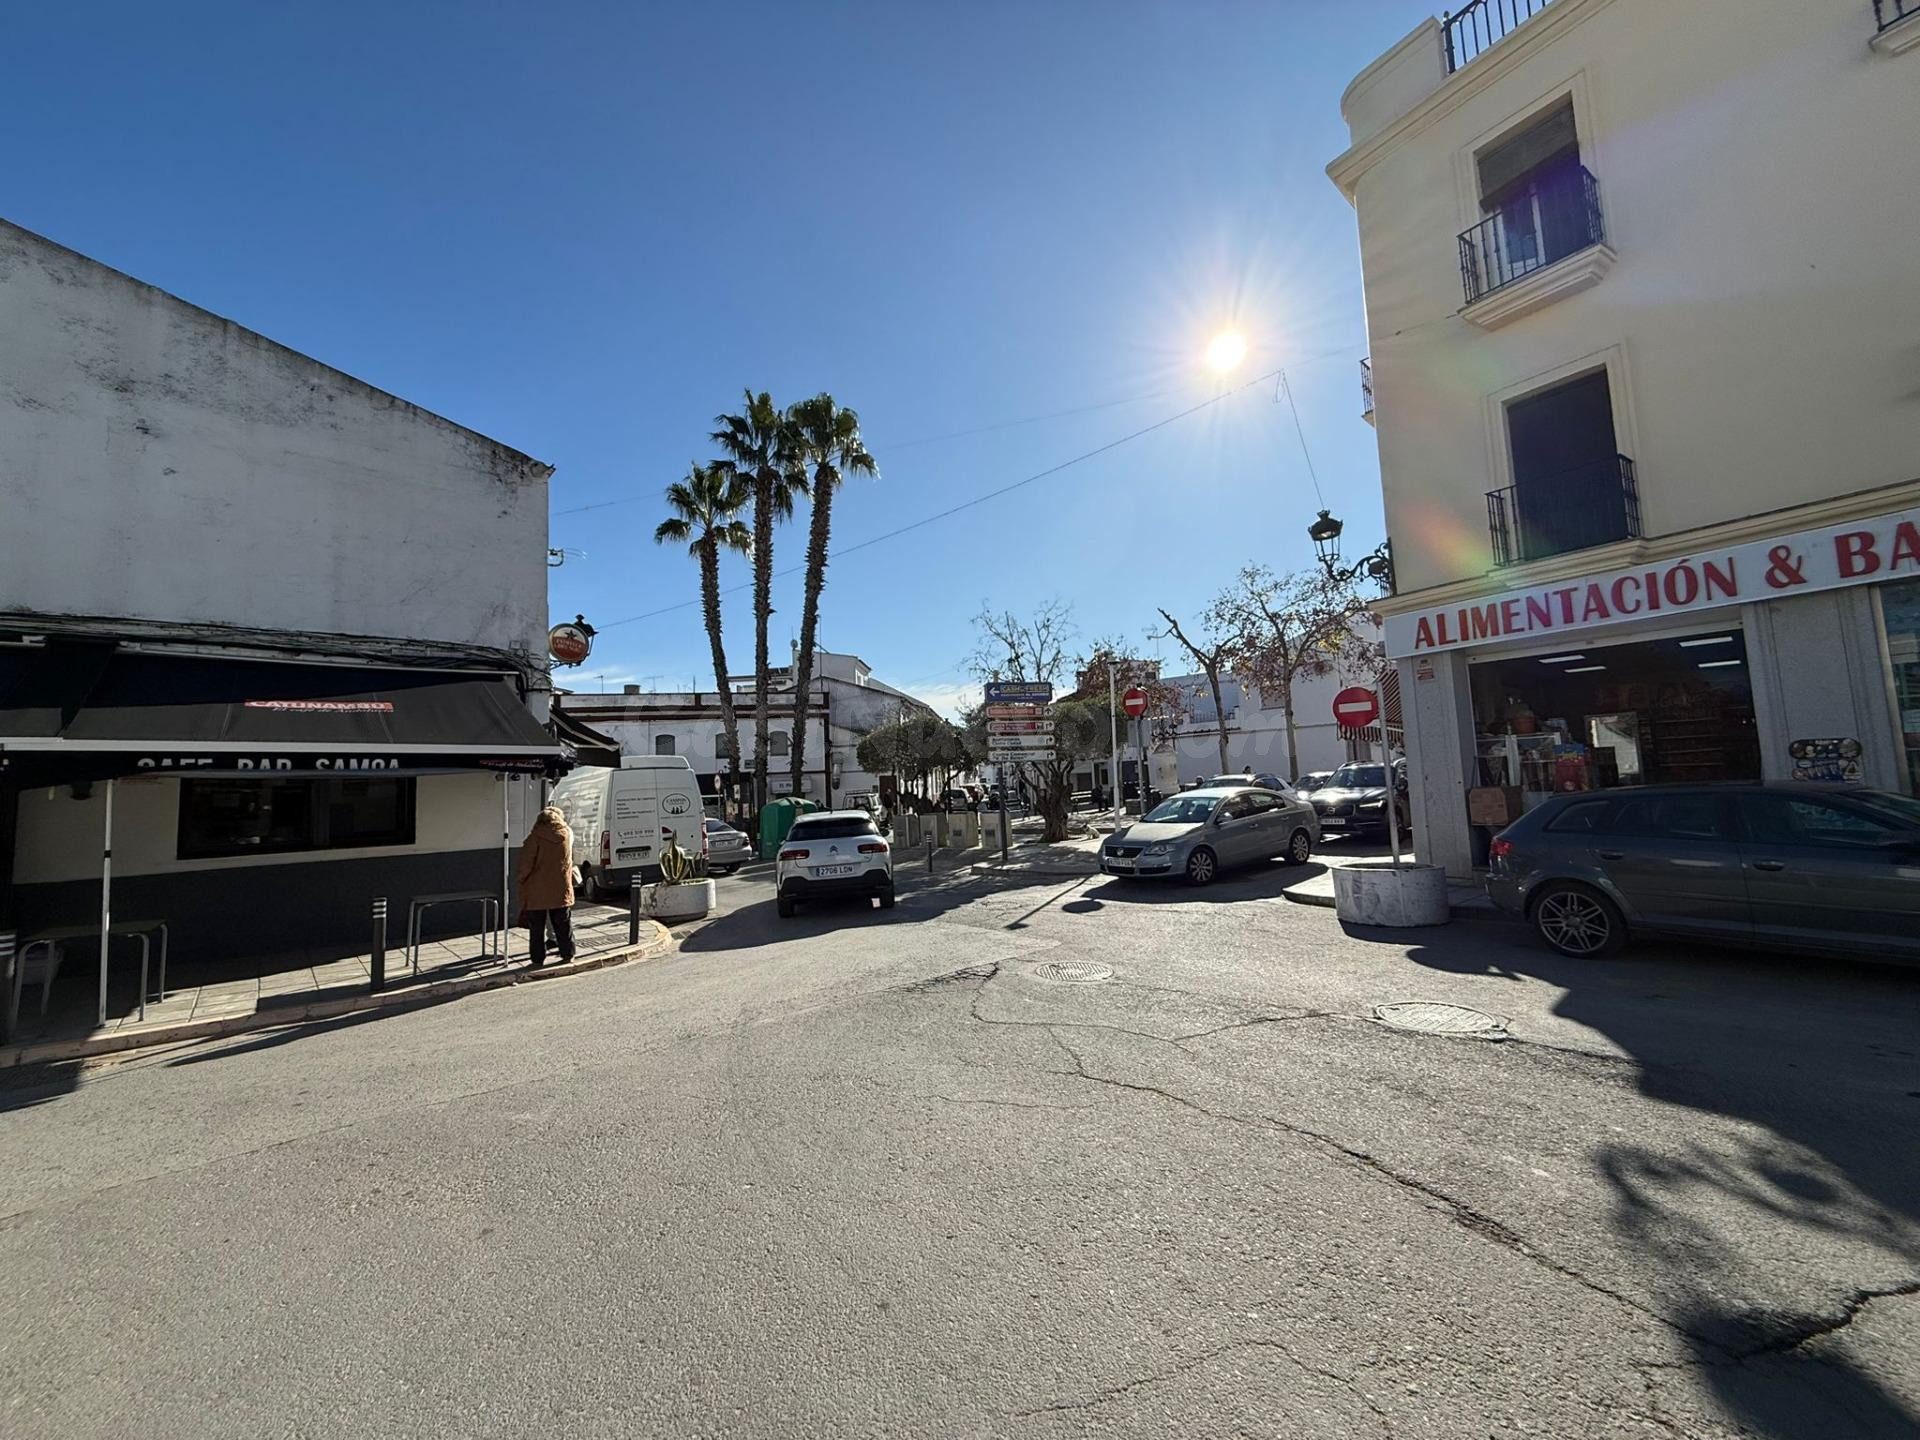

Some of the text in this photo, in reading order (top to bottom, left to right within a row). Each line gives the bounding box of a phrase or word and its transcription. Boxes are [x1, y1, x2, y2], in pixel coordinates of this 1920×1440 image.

[1414, 520, 1920, 650] ALIMENTACIÓN & BA
